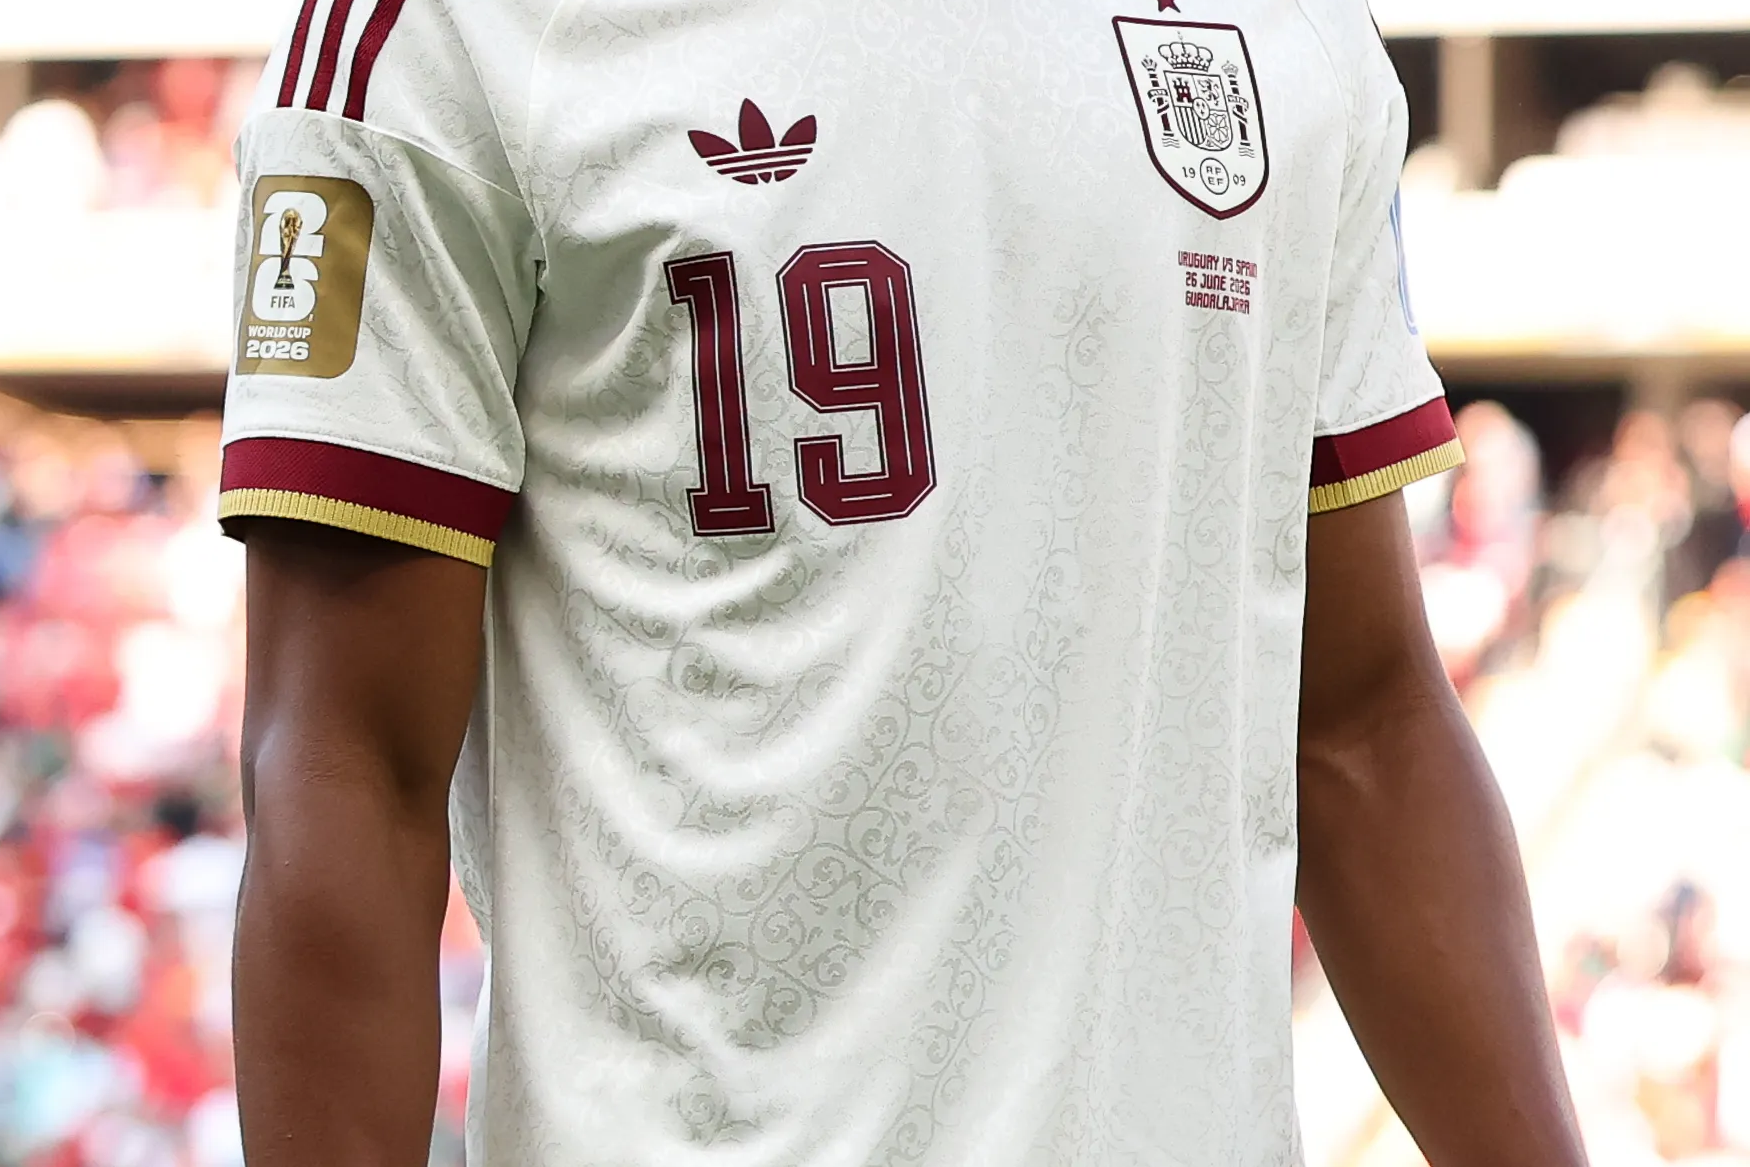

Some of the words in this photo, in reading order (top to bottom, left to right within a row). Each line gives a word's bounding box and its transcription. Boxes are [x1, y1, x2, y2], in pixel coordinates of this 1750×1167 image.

[1182, 166, 1196, 178] 19
[1232, 174, 1246, 186] 09
[1177, 250, 1219, 271] URUGUAY
[1222, 256, 1234, 273] VS
[1185, 271, 1198, 288] 26
[1200, 272, 1227, 292] JUNE
[1229, 276, 1251, 296] 2026
[270, 295, 296, 309] FIFA
[1185, 290, 1250, 315] GUADALAJARA
[248, 324, 287, 338] WORLD
[287, 325, 312, 339] CUP
[245, 339, 310, 361] 2026
[663, 240, 937, 537] 19
